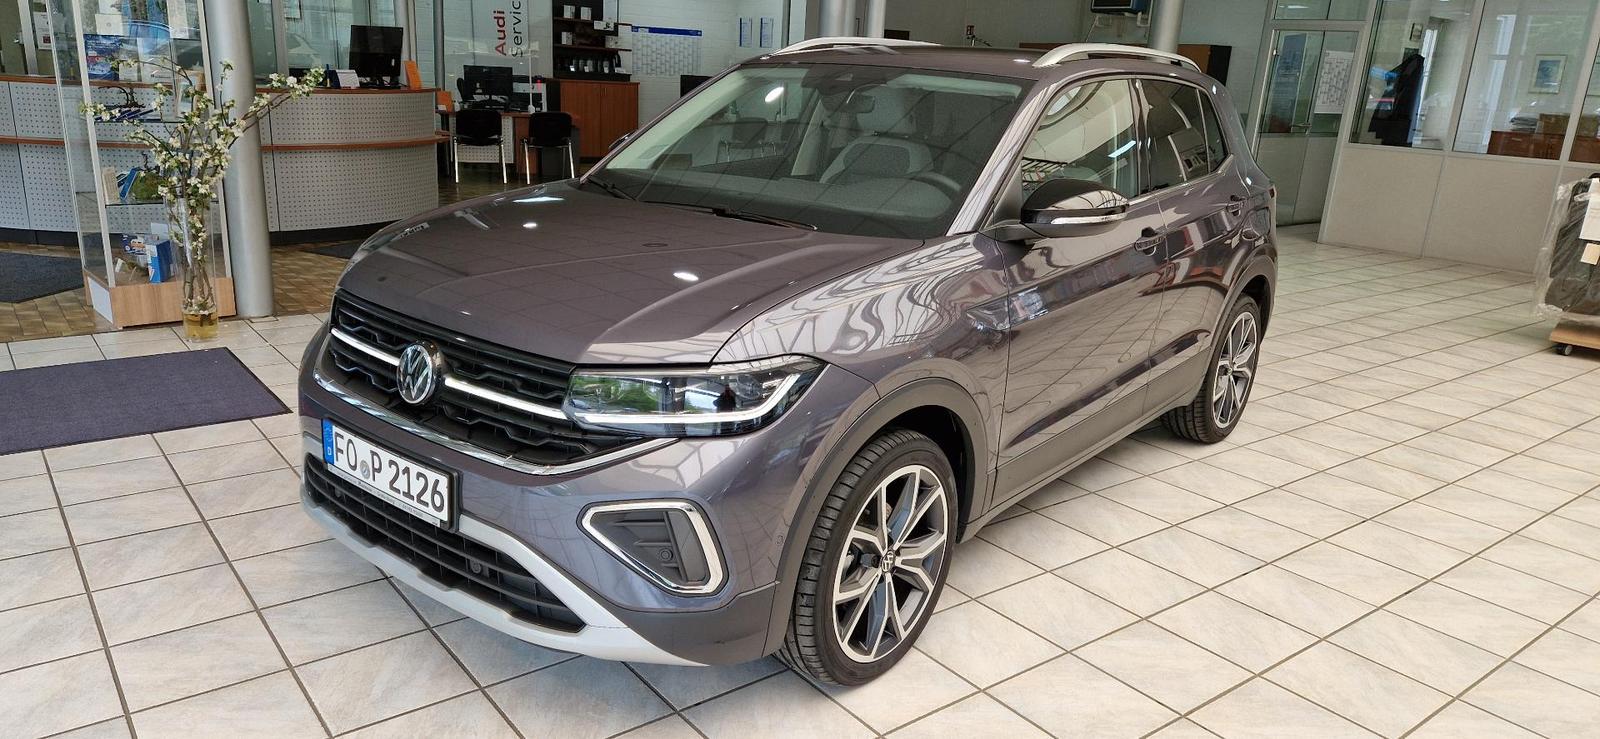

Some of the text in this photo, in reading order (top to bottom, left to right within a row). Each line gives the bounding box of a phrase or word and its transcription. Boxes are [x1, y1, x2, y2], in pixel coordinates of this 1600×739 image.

[493, 10, 506, 56] Audi
[334, 431, 358, 472] FO
[369, 449, 382, 481] P
[388, 459, 445, 513] 2126
